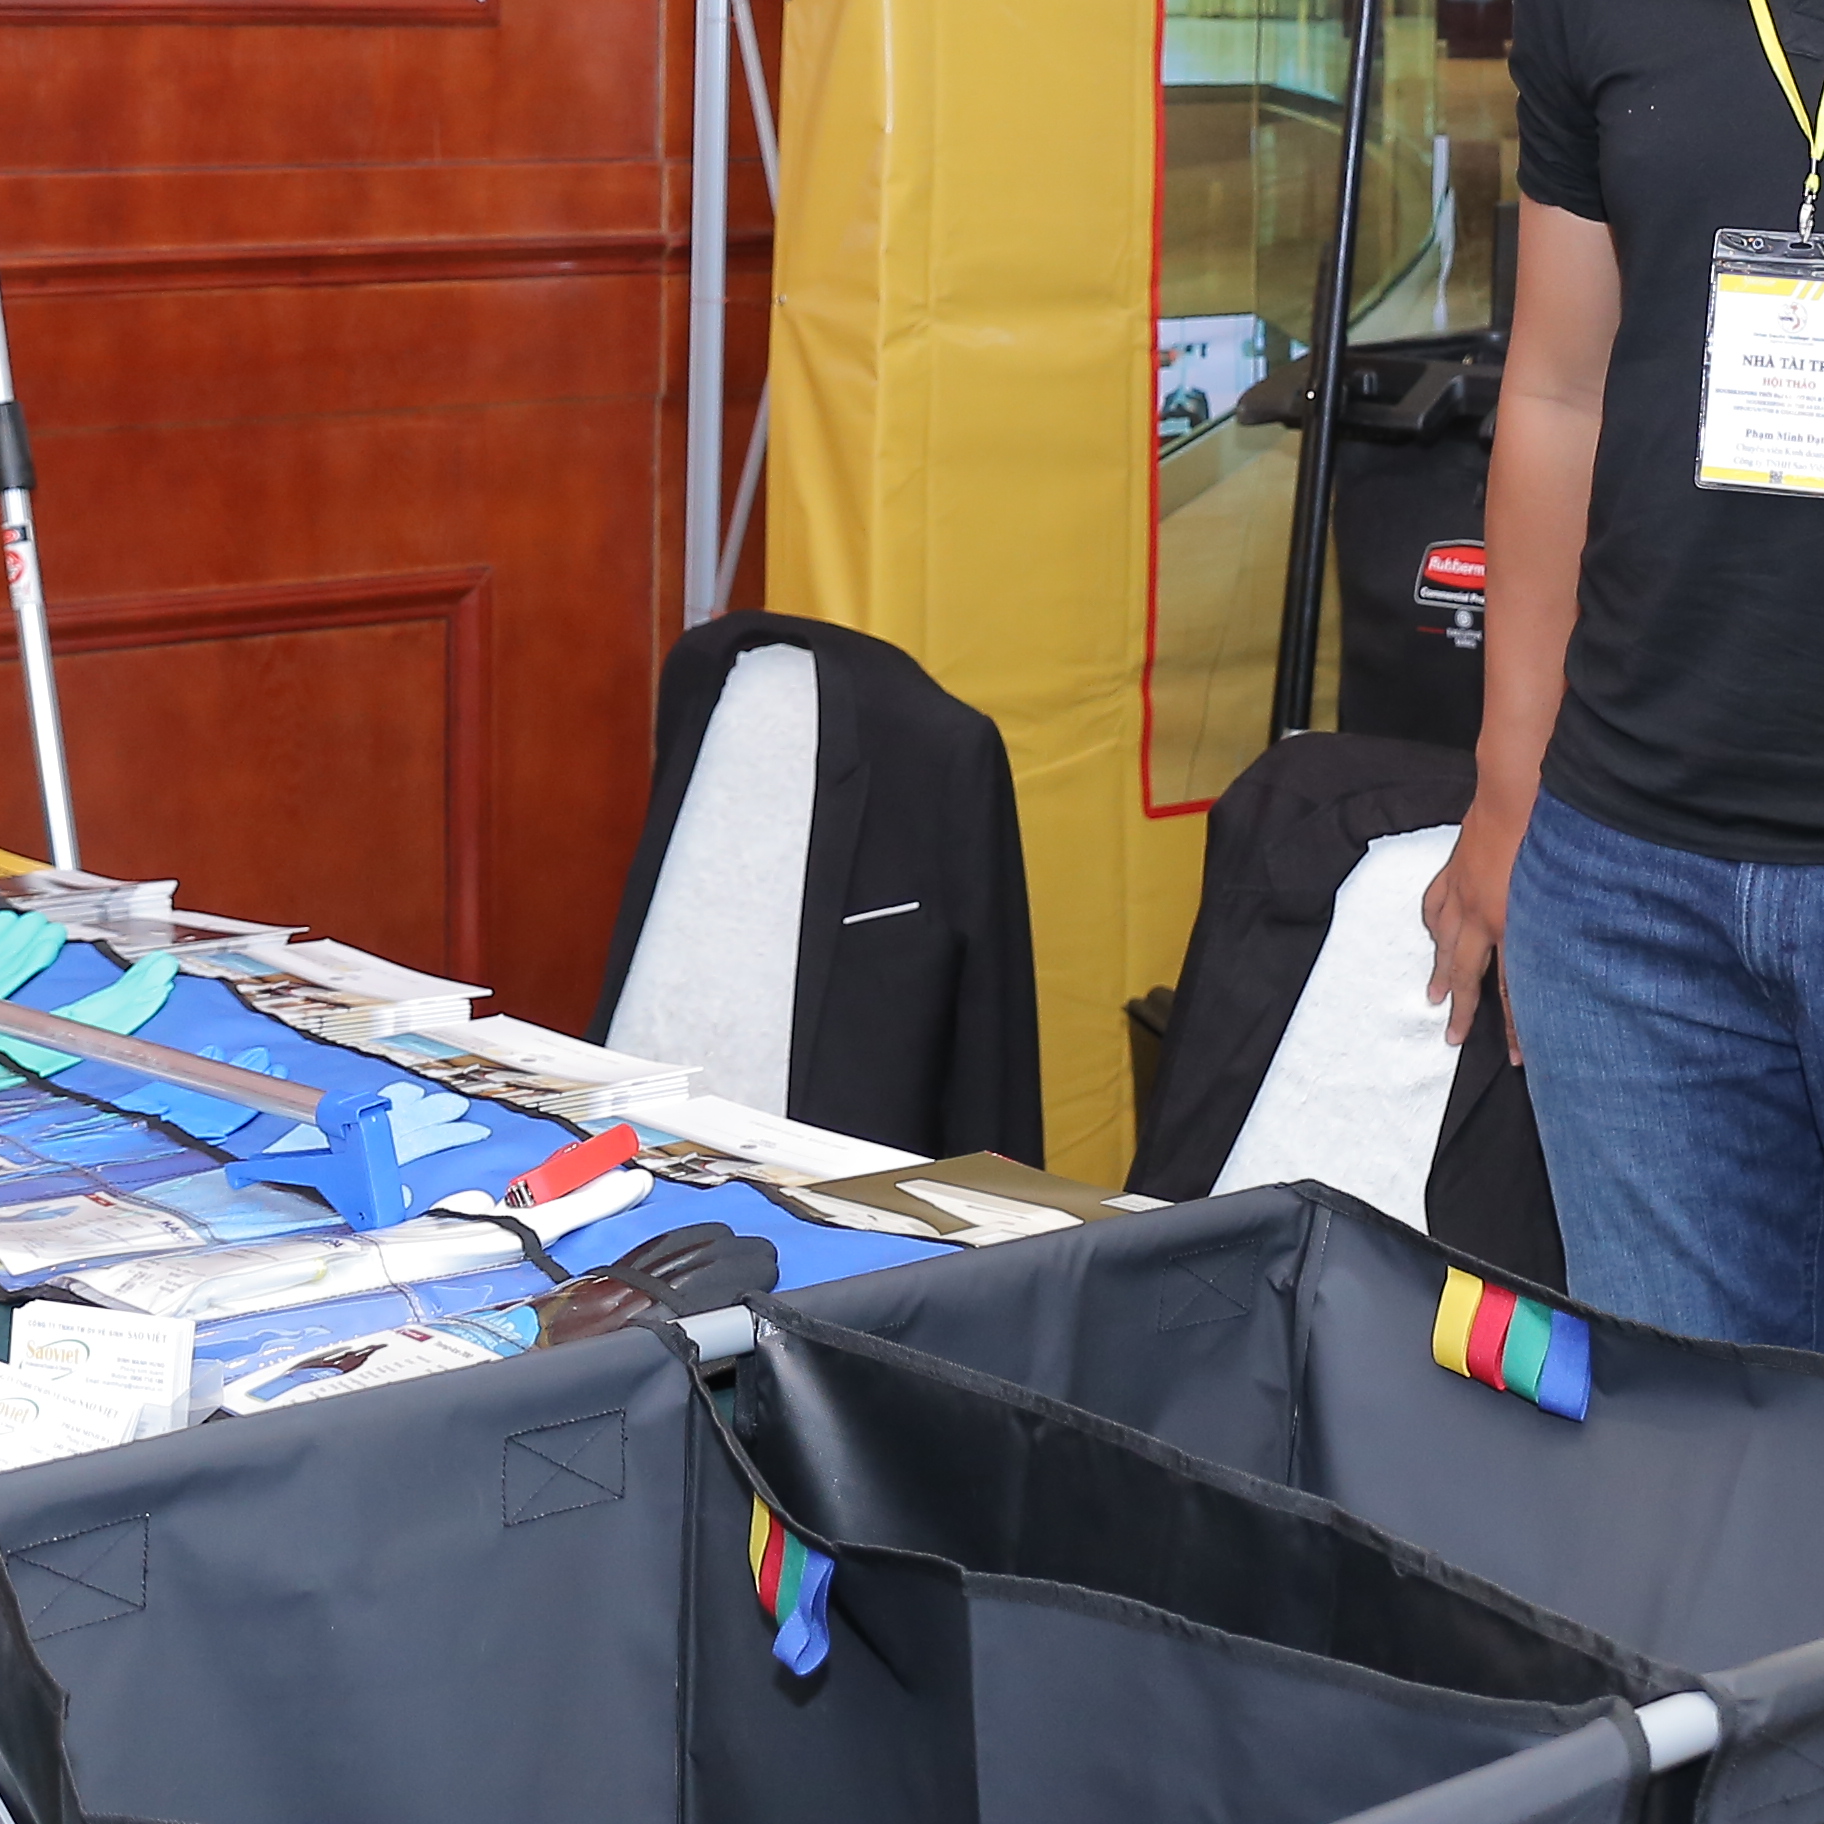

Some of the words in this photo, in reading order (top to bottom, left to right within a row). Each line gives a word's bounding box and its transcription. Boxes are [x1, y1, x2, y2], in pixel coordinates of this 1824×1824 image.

[1742, 354, 1776, 369] NHÀ
[1780, 356, 1806, 372] TÀI
[1745, 428, 1774, 441] Phạm
[1776, 431, 1804, 443] Minh
[1428, 555, 1485, 577] Rubberm
